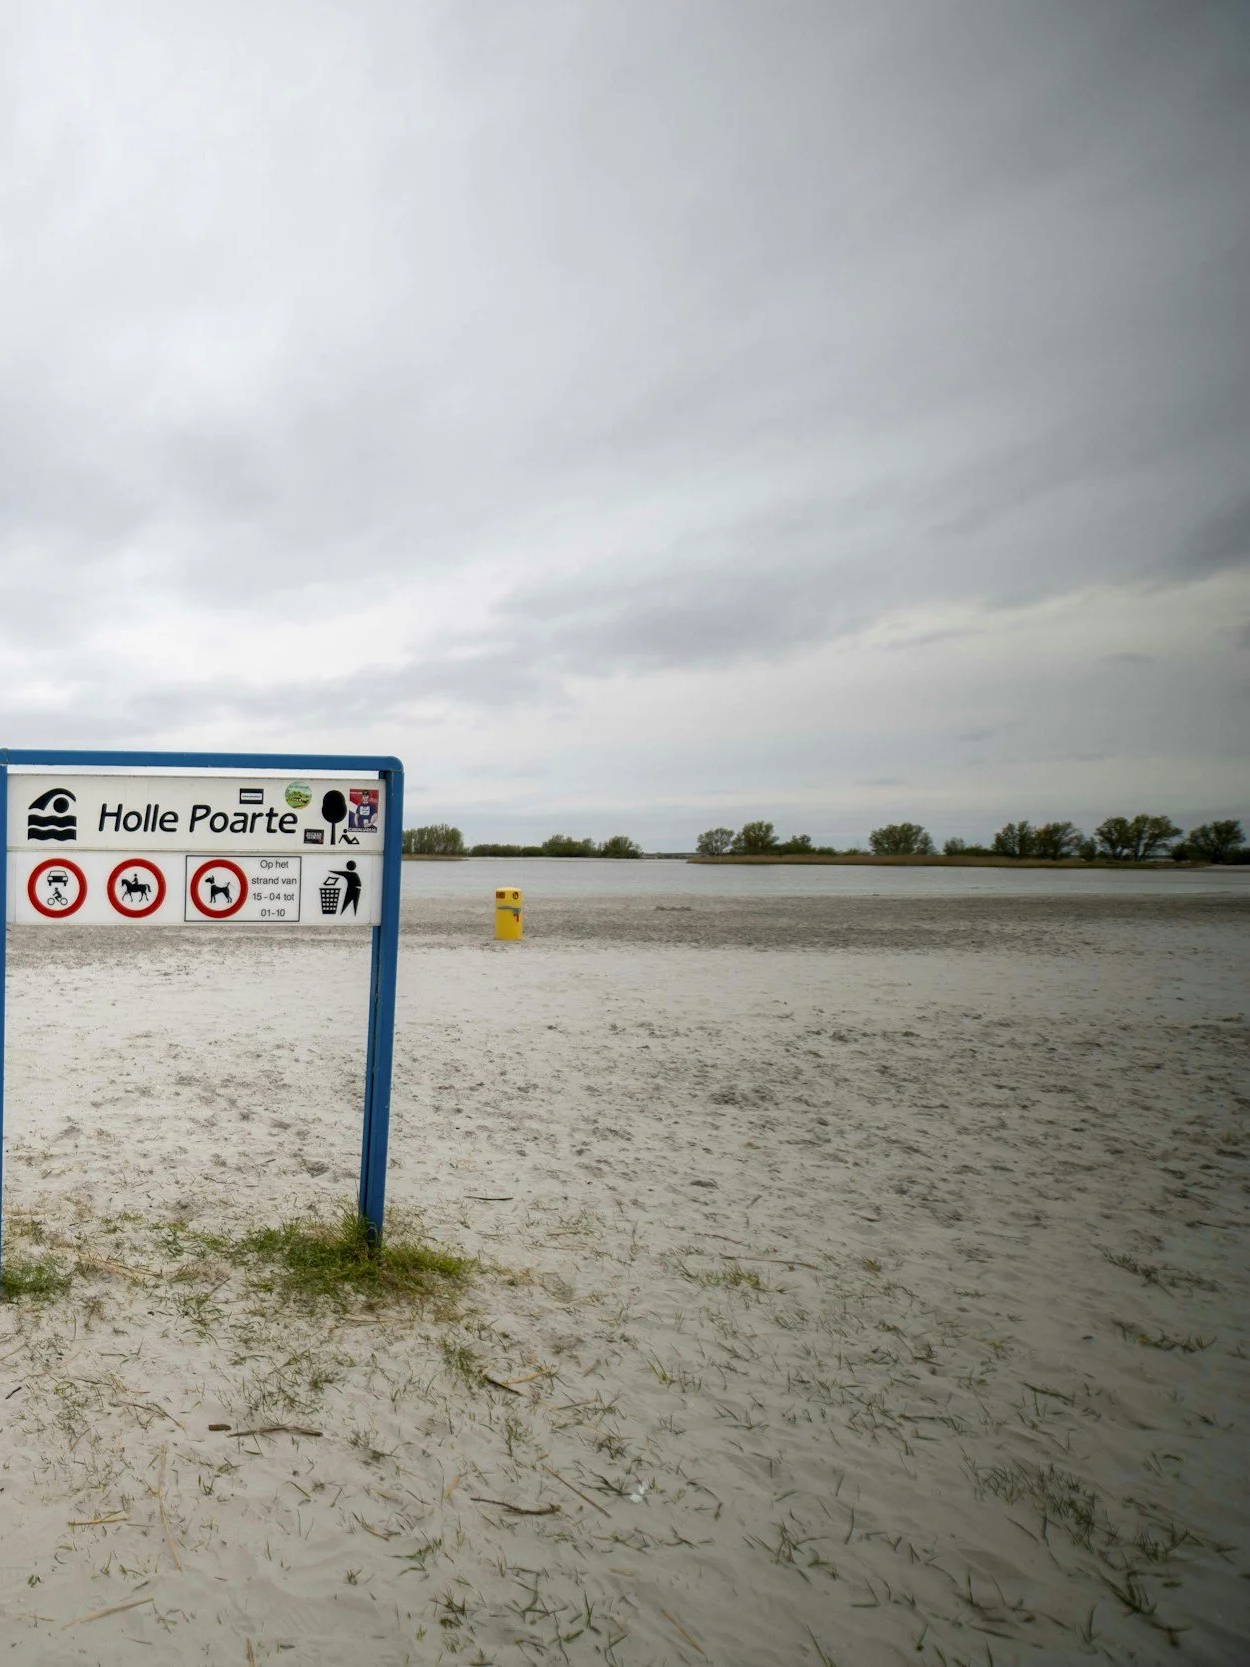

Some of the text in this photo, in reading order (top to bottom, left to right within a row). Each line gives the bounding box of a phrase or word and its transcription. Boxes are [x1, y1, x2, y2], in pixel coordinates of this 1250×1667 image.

[99, 803, 298, 833] Holle Poarte
[260, 860, 289, 870] Op het
[251, 877, 279, 885] strand
[283, 893, 295, 901] tot
[261, 909, 285, 917] 01-10
